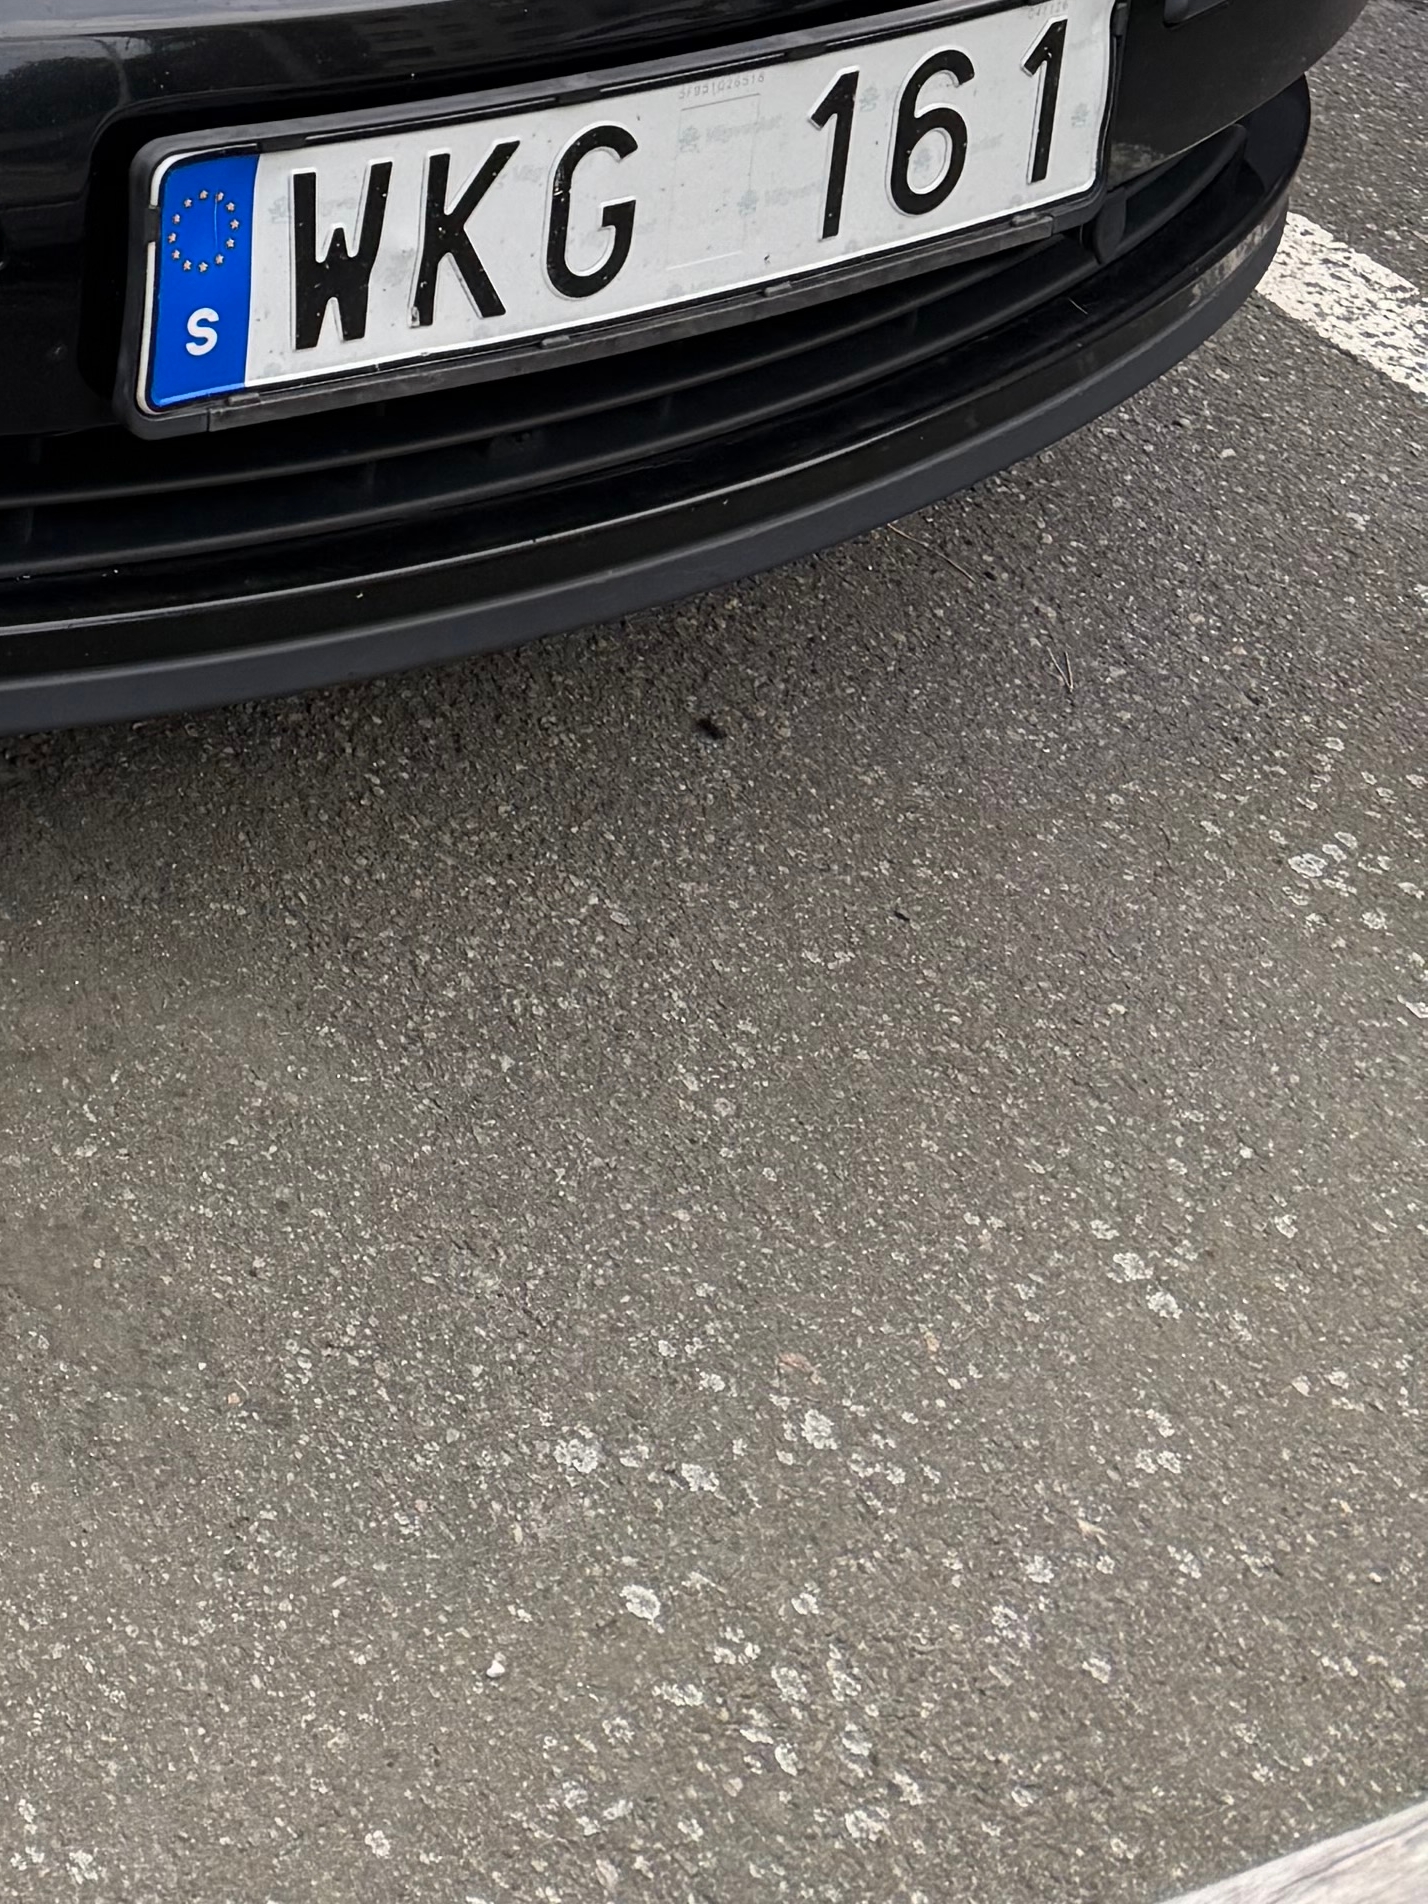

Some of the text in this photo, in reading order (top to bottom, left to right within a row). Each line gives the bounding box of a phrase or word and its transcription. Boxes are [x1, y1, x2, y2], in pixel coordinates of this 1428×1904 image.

[292, 18, 1067, 350] WKG 161
[185, 307, 219, 356] S
